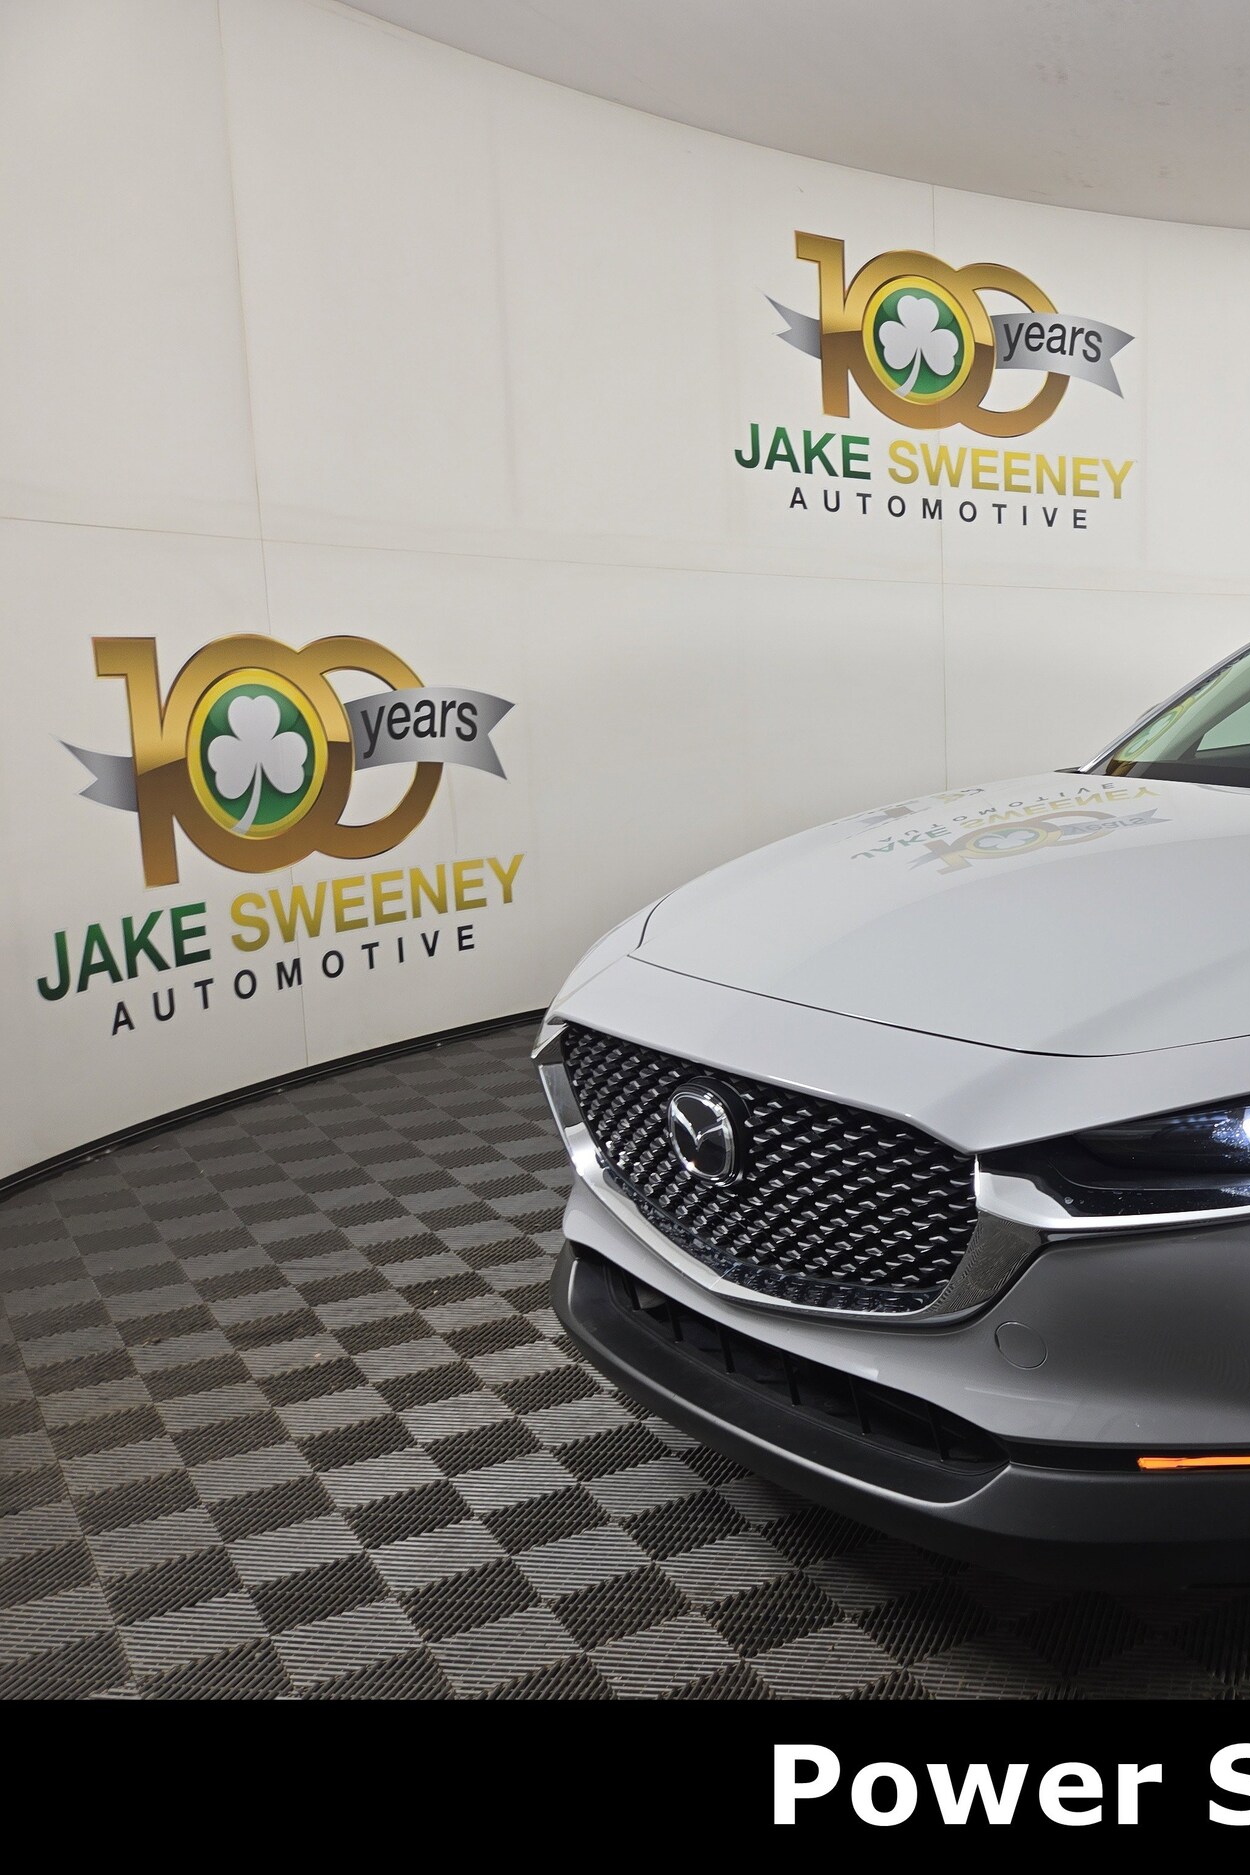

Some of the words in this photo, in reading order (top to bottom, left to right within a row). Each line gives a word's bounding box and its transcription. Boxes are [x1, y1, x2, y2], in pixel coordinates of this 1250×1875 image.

[794, 230, 1070, 438] 100
[1003, 320, 1102, 364] years
[734, 422, 872, 481] JAKE
[887, 440, 1134, 500] SWEENEY
[789, 486, 1088, 529] AUTOMOTIVE
[91, 633, 444, 889] 100
[360, 698, 478, 758] years
[36, 902, 211, 1001] JAKE
[229, 853, 525, 953] SWEENEY
[111, 924, 475, 1036] AUTOMOTIVE
